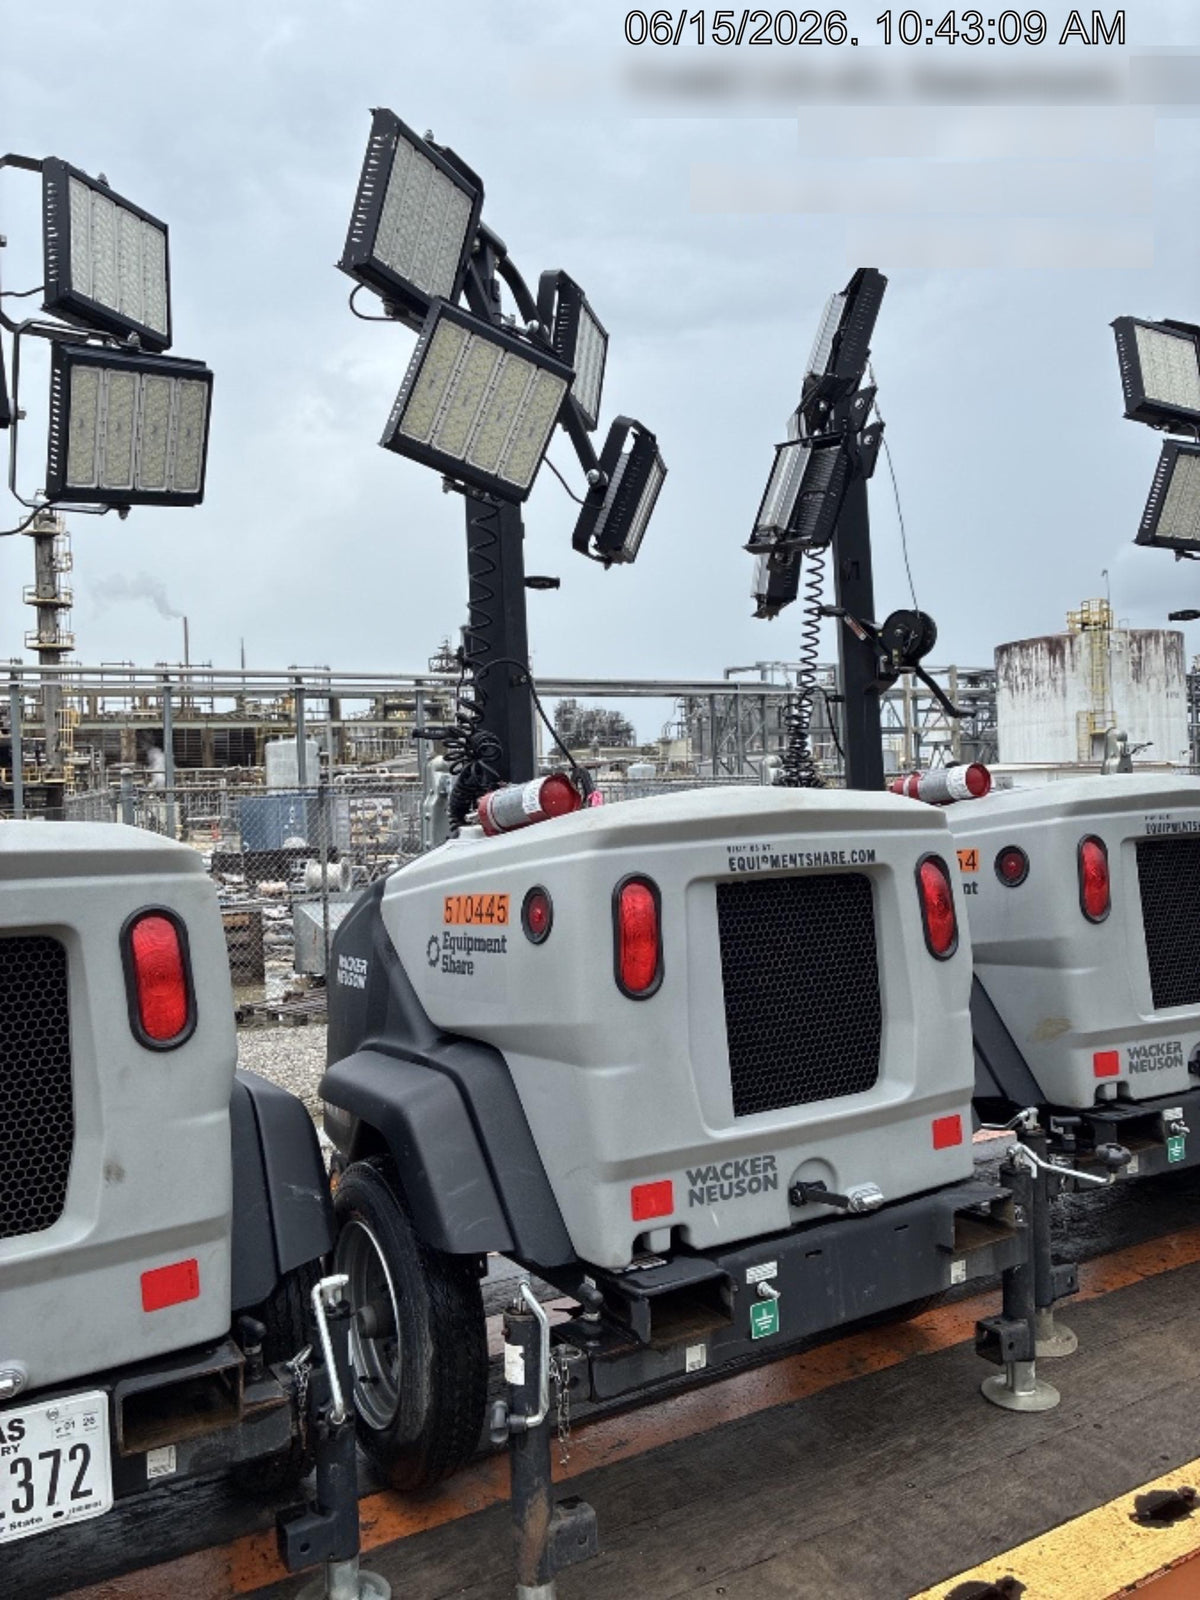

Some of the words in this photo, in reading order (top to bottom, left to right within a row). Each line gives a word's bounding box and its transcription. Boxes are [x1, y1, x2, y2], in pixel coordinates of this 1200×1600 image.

[445, 895, 507, 924] 510445
[442, 931, 508, 956] Equipment
[441, 954, 474, 976] Share
[1127, 1041, 1183, 1060] WACKER
[1128, 1054, 1184, 1075] NEUSON
[686, 1155, 778, 1187] WACKER
[688, 1173, 778, 1208] NEUSON
[1, 1443, 20, 1456] RY
[0, 1442, 93, 1519] 372
